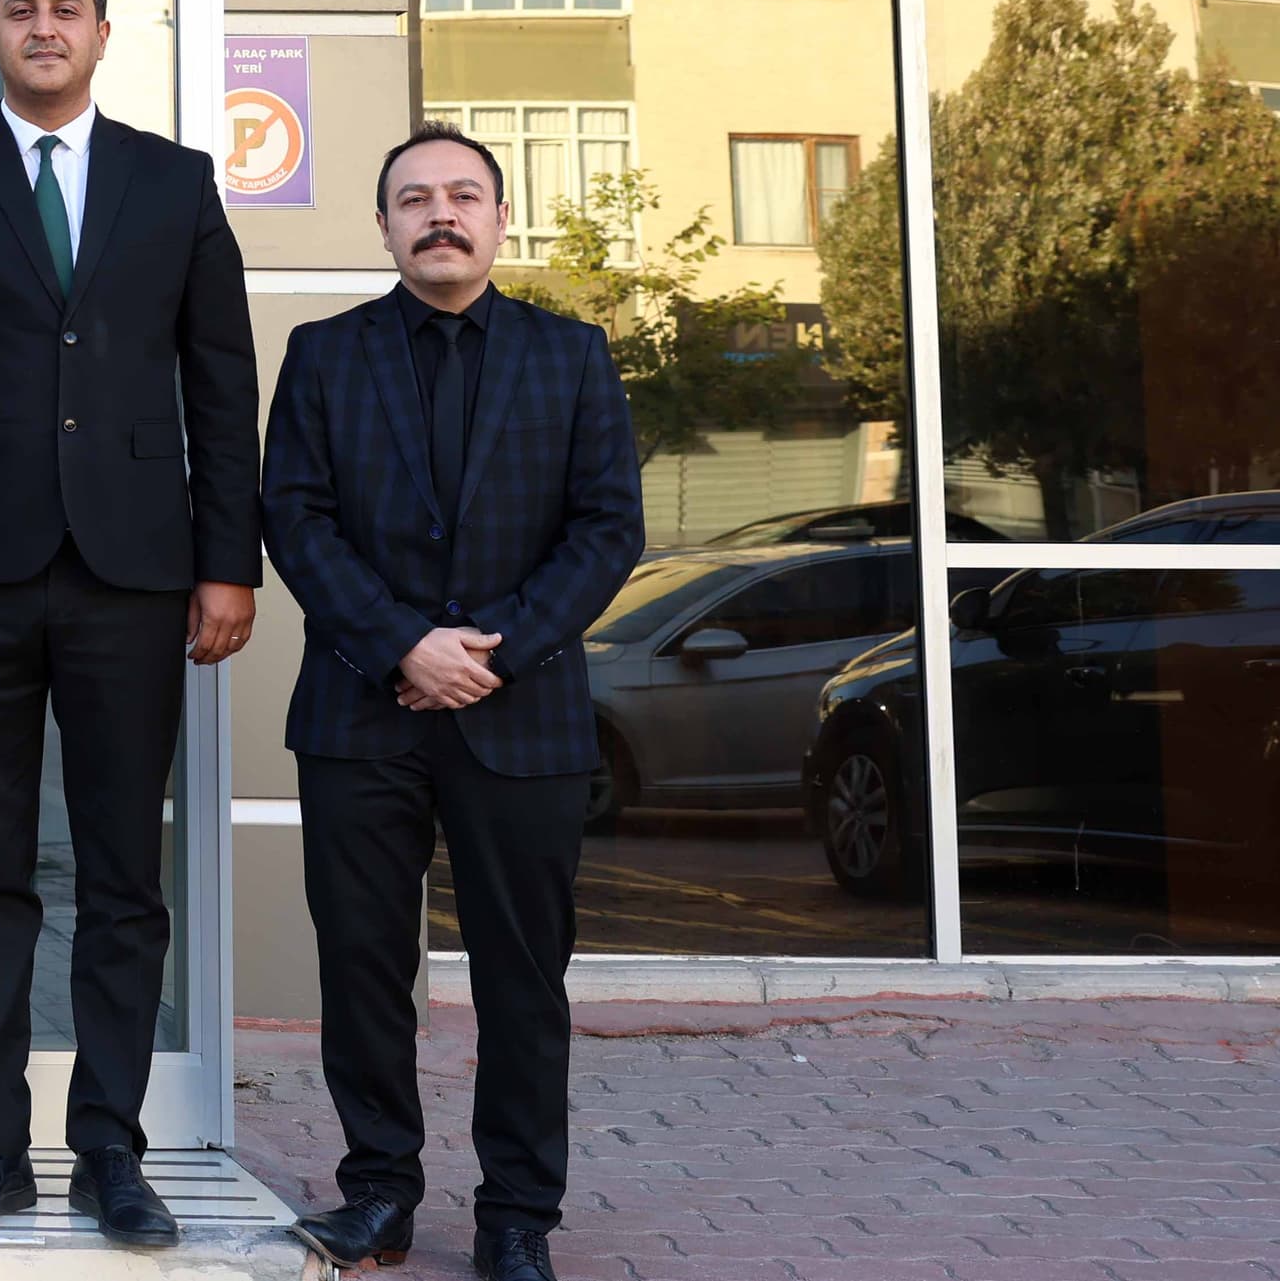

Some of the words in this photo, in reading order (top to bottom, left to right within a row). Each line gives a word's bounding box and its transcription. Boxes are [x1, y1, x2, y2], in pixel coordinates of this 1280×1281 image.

[232, 48, 268, 61] ARAÇ
[270, 48, 304, 59] PARK
[232, 62, 263, 74] YERİ
